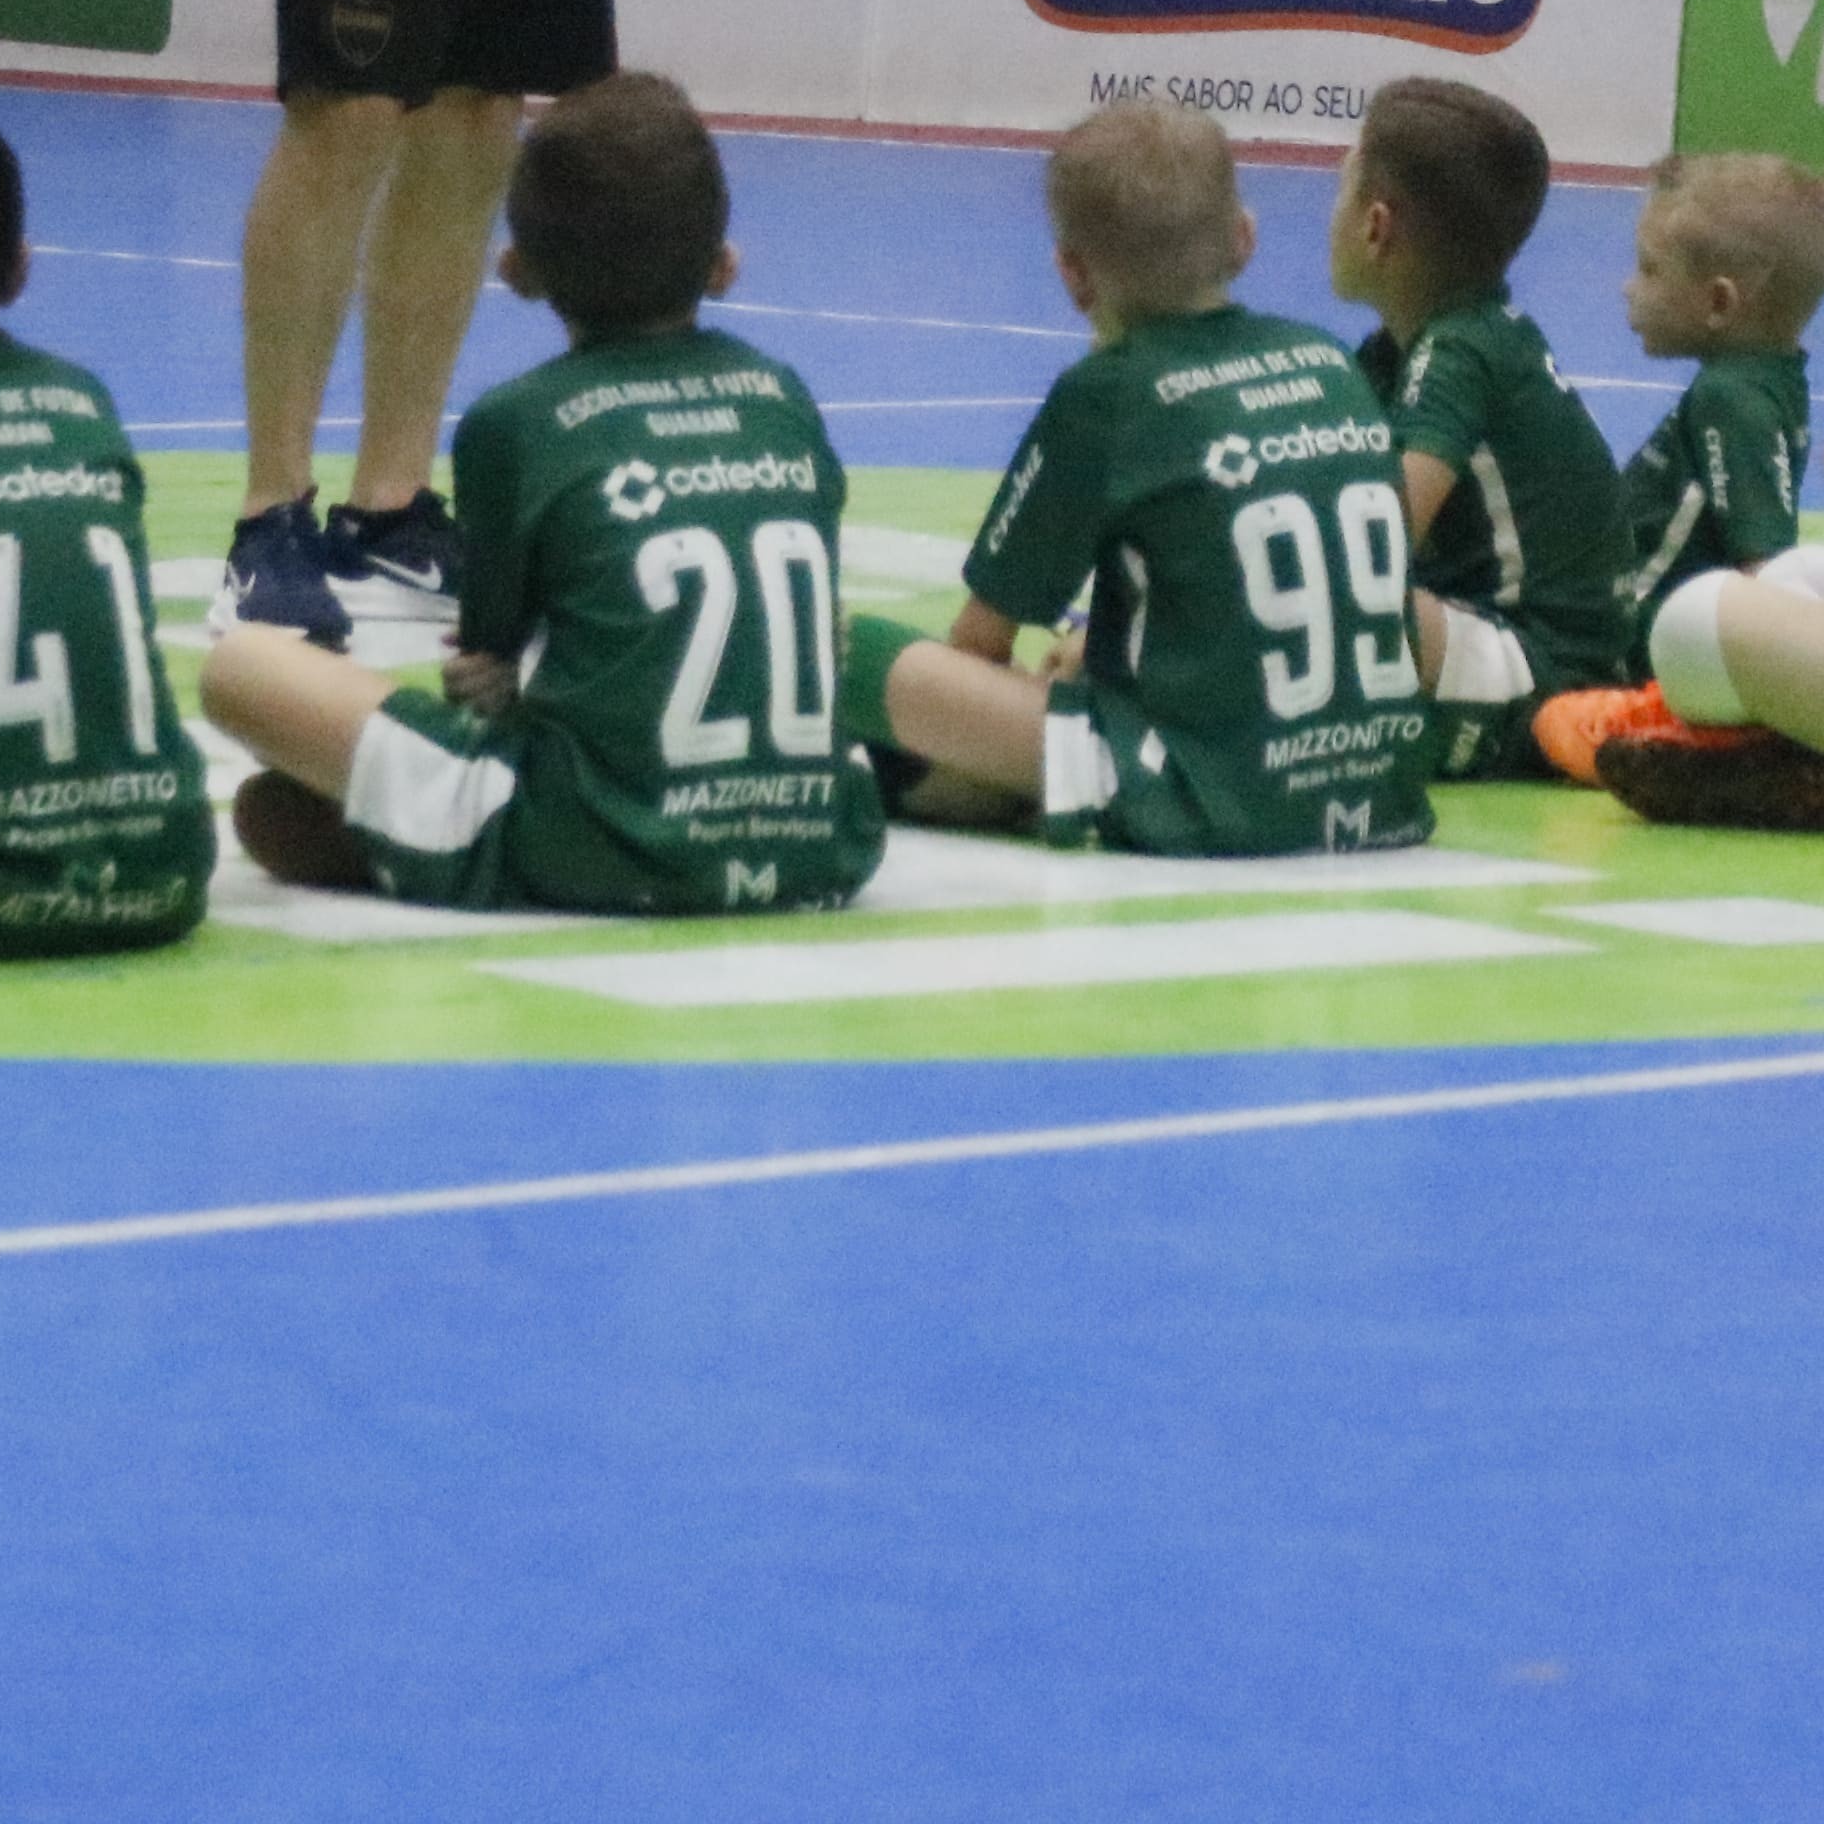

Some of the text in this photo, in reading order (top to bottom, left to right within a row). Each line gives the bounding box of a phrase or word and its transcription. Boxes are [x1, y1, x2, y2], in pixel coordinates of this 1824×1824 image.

[1167, 77, 1254, 112] SABOR
[1263, 83, 1305, 115] AO
[1312, 85, 1366, 120] SEU
[634, 519, 836, 769] 20
[1231, 480, 1422, 721] 99
